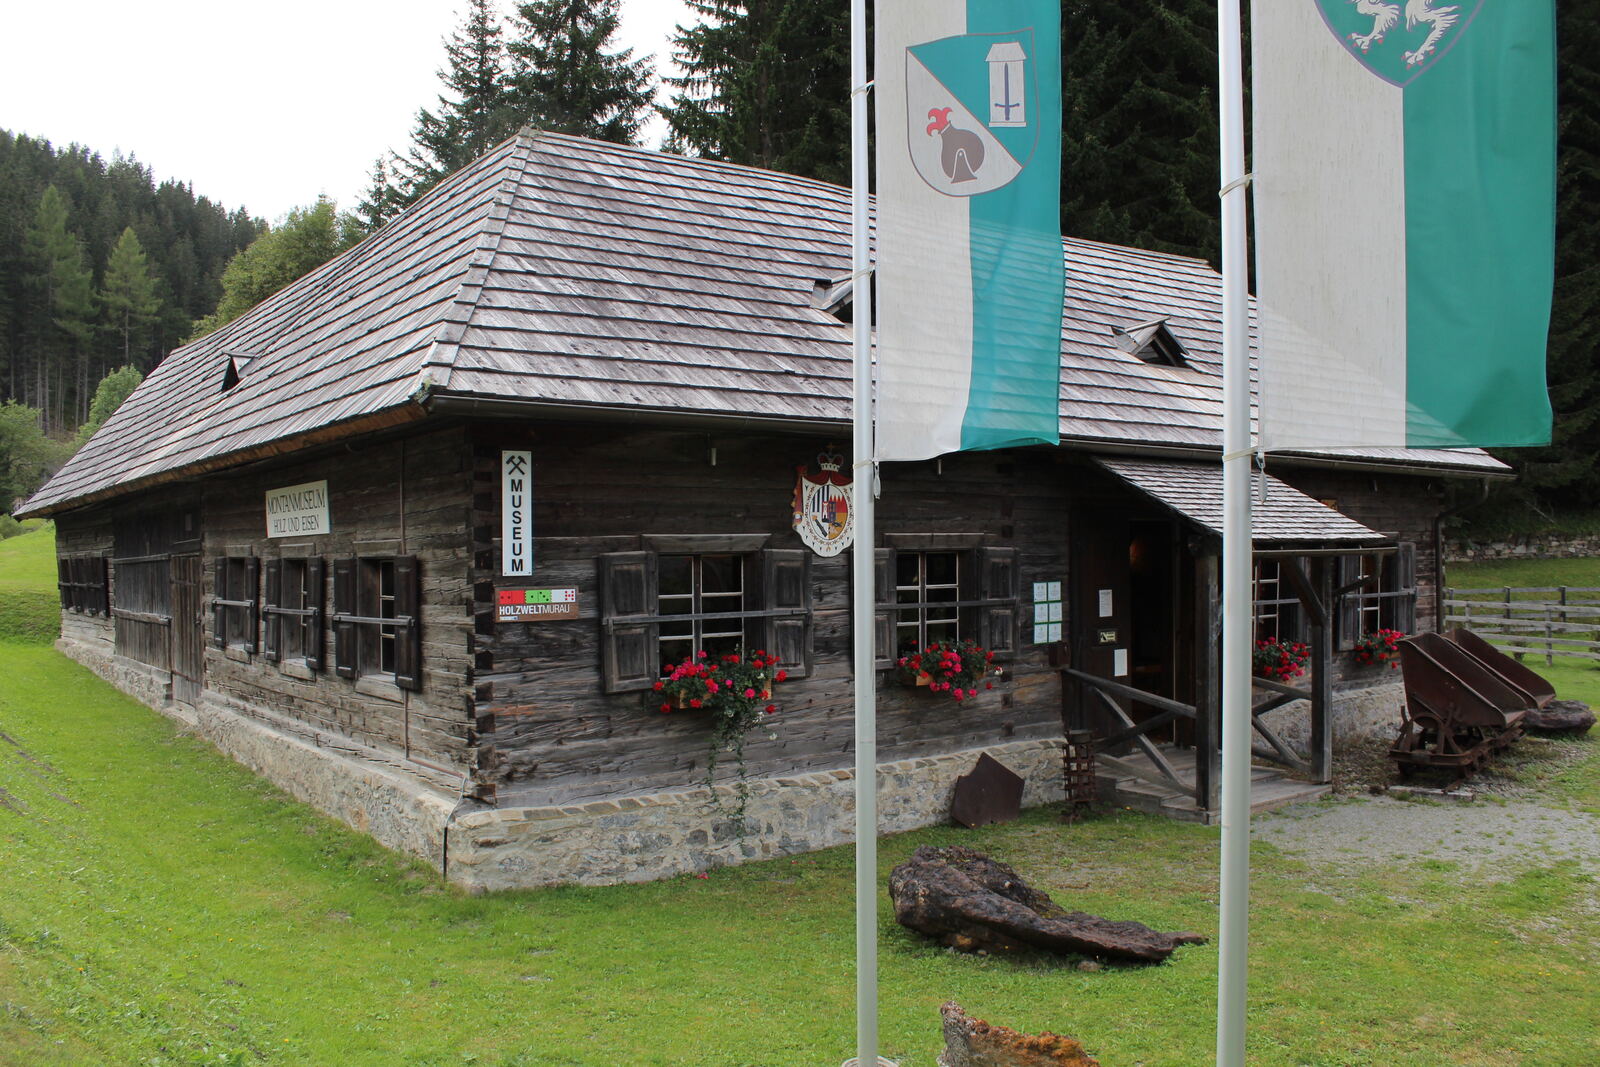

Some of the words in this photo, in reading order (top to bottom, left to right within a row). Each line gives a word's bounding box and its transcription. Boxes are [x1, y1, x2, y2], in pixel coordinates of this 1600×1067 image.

[267, 488, 325, 514] MONTANMUSEUM
[274, 518, 287, 532] HOLZ
[288, 517, 300, 532] UND
[302, 514, 319, 531] EISEN
[511, 479, 523, 572] MUSEUM
